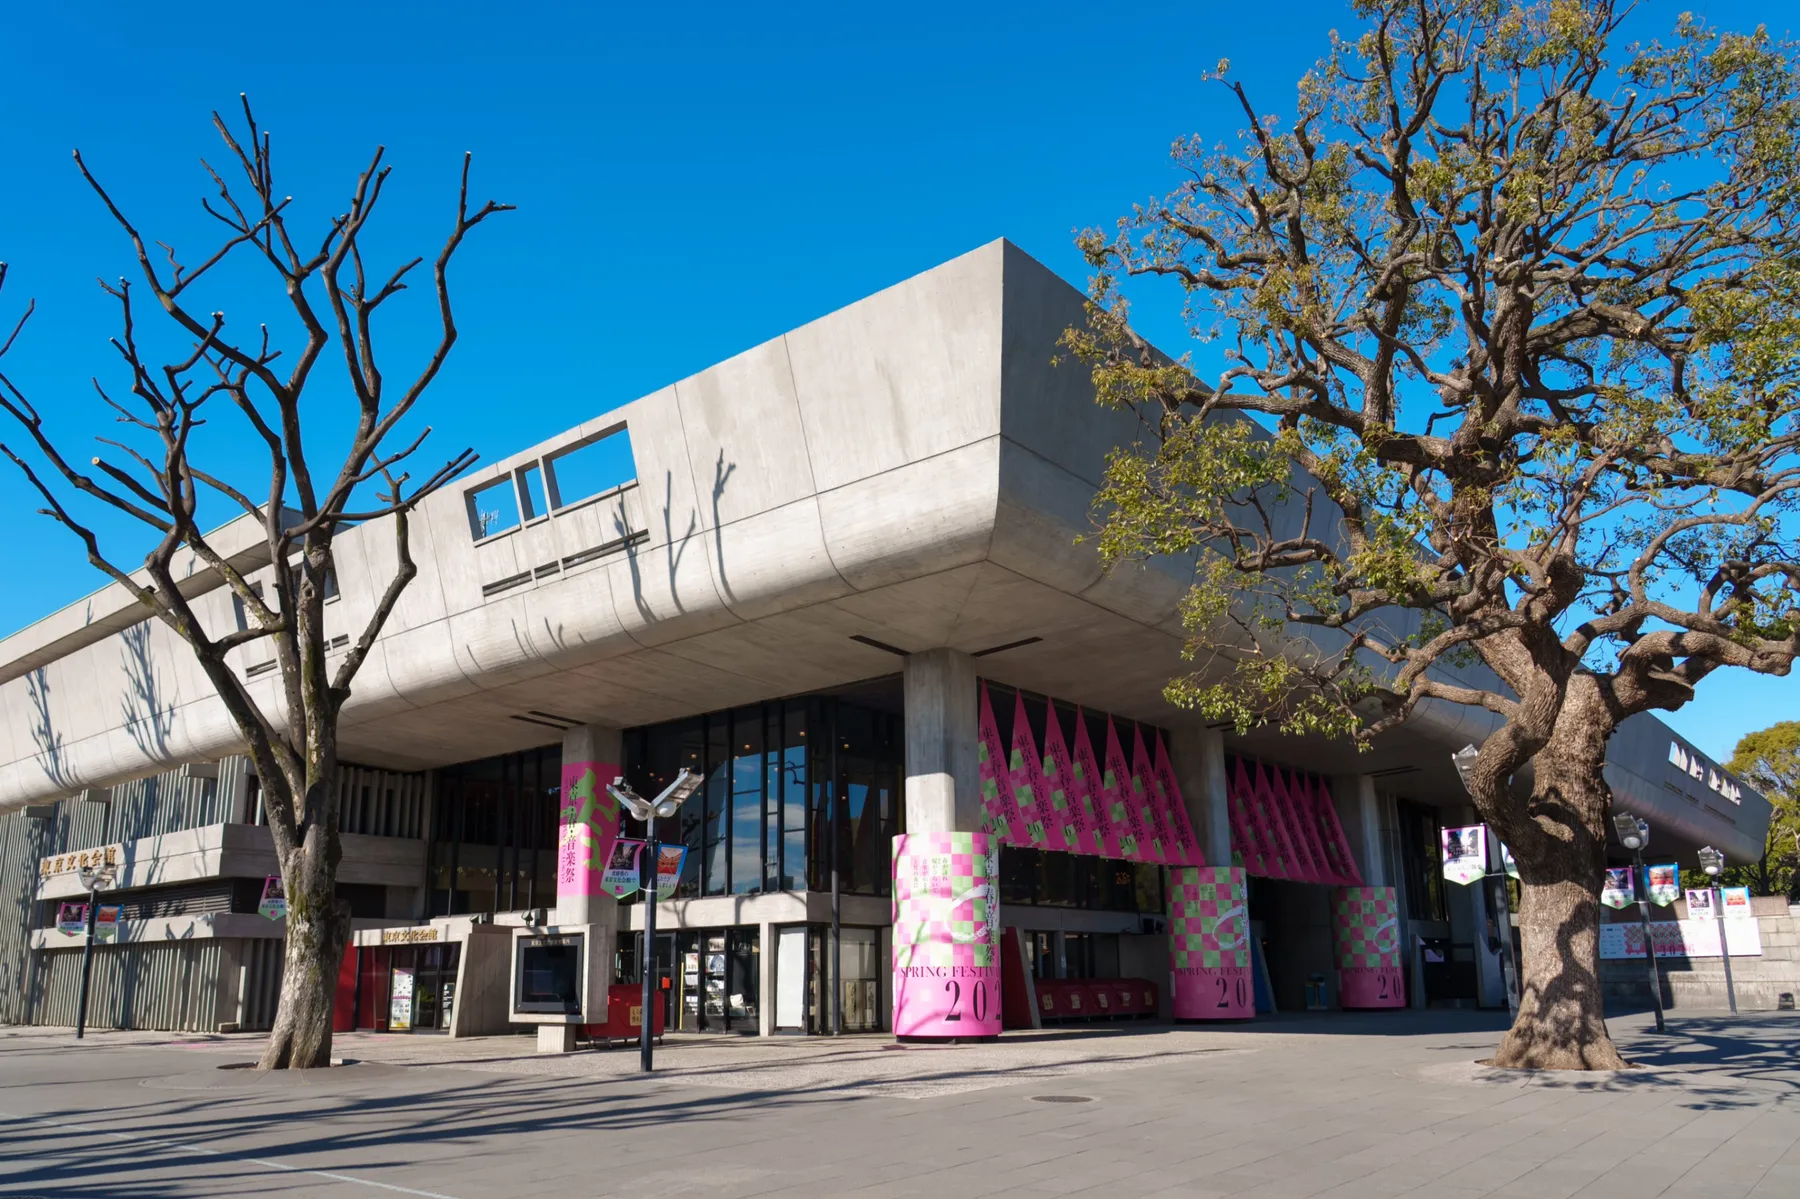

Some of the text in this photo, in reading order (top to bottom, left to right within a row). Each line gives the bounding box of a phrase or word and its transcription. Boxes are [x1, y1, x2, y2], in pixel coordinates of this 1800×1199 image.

[41, 847, 116, 877] 東京文化会館
[383, 928, 438, 943] 東京文化会館
[900, 966, 946, 978] SPRING
[1179, 967, 1216, 976] SPRING
